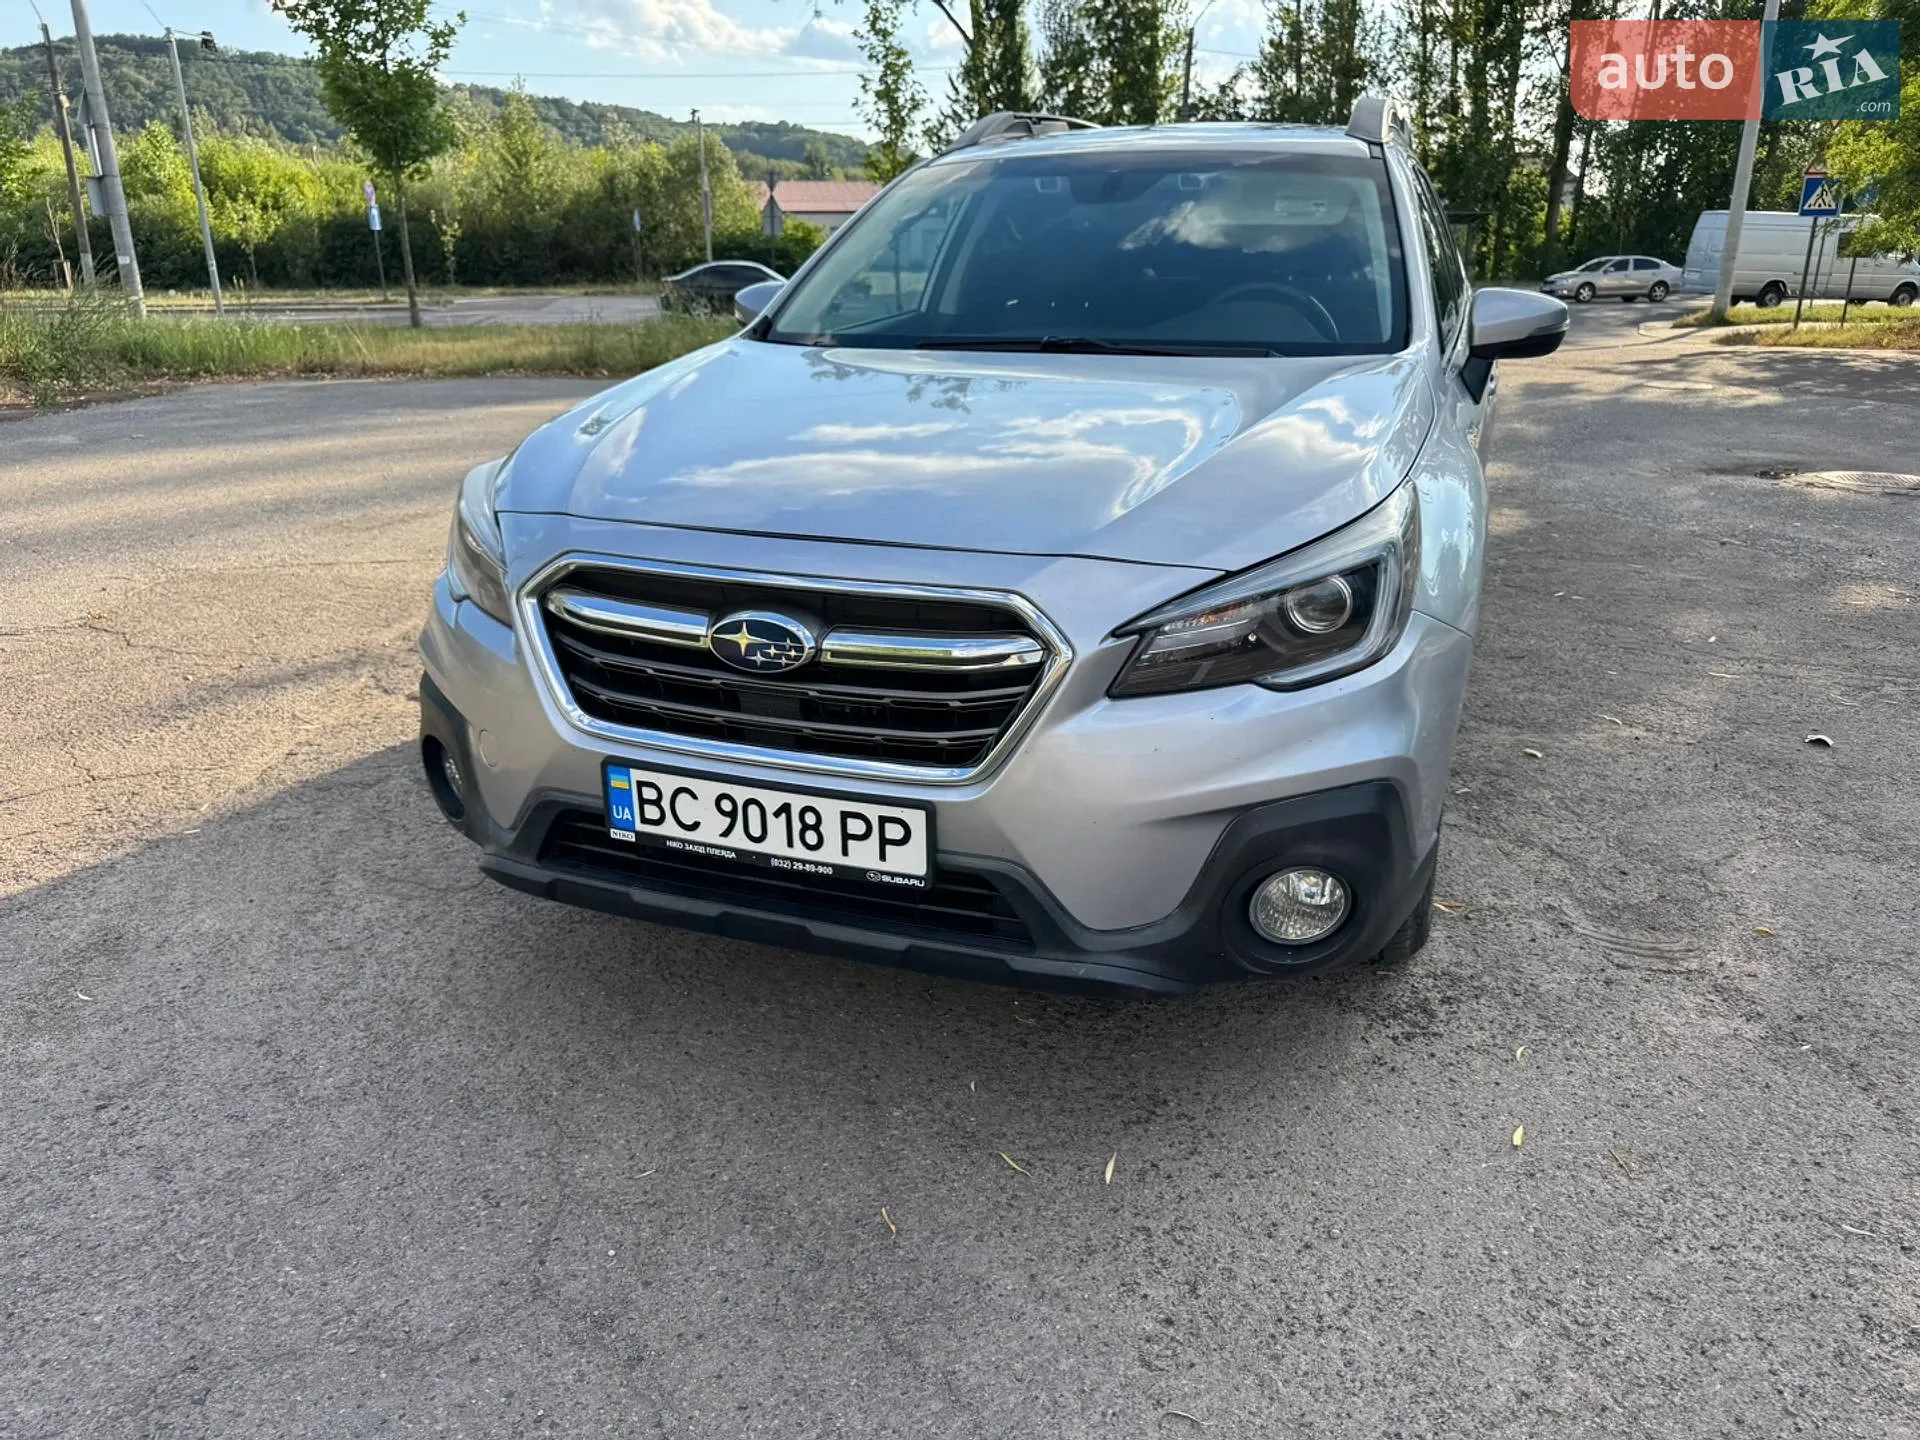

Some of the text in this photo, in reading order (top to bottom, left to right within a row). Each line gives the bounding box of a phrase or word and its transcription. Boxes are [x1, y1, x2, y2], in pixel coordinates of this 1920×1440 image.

[612, 805, 633, 821] UA
[635, 779, 912, 862] BC 9018 PP
[611, 830, 634, 840] NIKO
[881, 874, 925, 887] SUBARU
